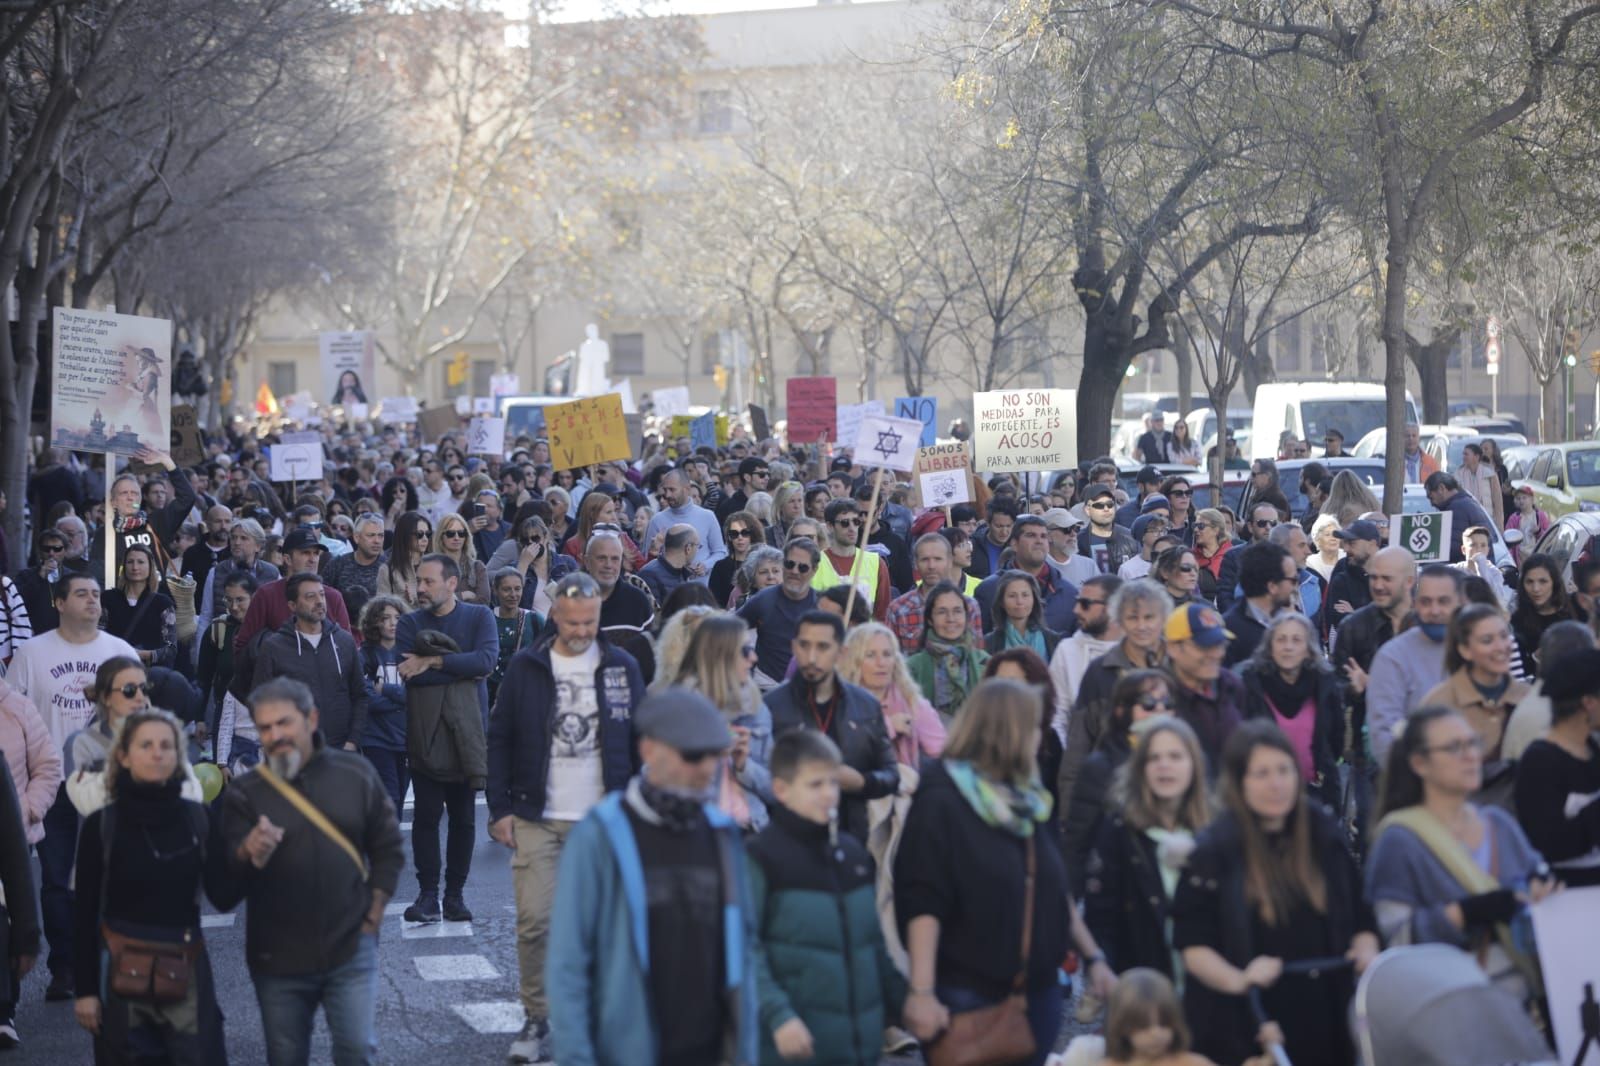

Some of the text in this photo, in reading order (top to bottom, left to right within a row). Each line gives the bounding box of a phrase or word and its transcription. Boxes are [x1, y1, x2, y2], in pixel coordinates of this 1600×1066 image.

[1002, 392, 1050, 407] NO SON
[900, 399, 934, 426] NO
[982, 407, 1061, 420] MEDIDAS PARA
[1047, 417, 1060, 430] ES
[998, 432, 1053, 450] ACOSO
[920, 443, 962, 458] SOMOS
[918, 455, 968, 472] LIBRES
[986, 454, 1062, 468] PARA VACUNARTE
[1412, 514, 1432, 528] NO
[50, 661, 98, 680] DNM BRA
